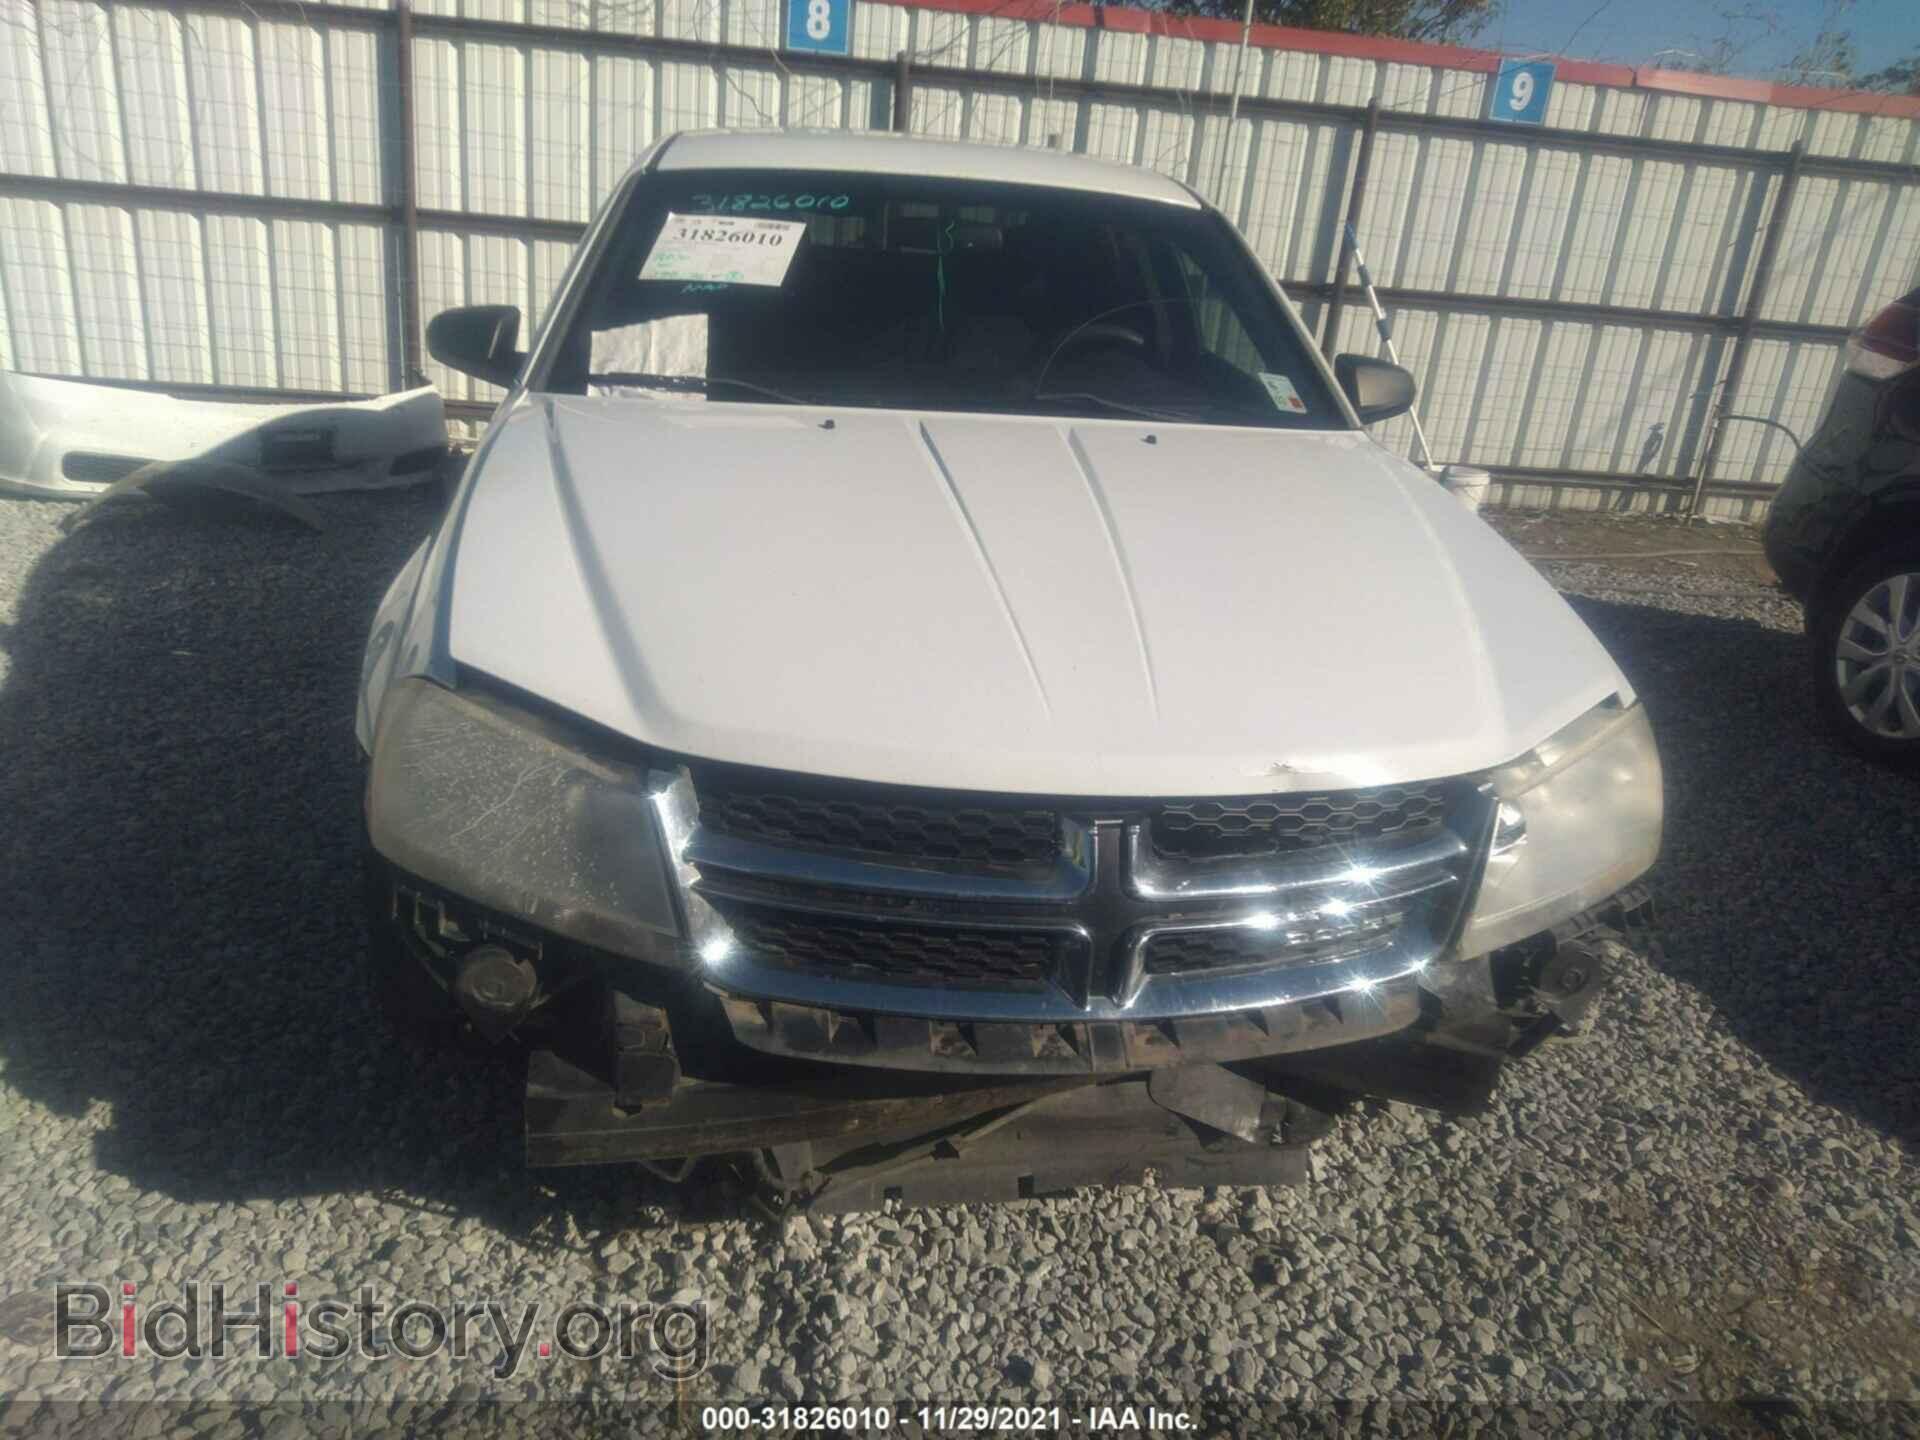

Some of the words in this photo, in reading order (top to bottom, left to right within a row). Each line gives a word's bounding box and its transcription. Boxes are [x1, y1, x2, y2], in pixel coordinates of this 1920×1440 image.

[806, 0, 831, 41] 8
[1509, 71, 1534, 112] 9
[691, 192, 849, 211] 31826010
[672, 227, 783, 247] 31826010
